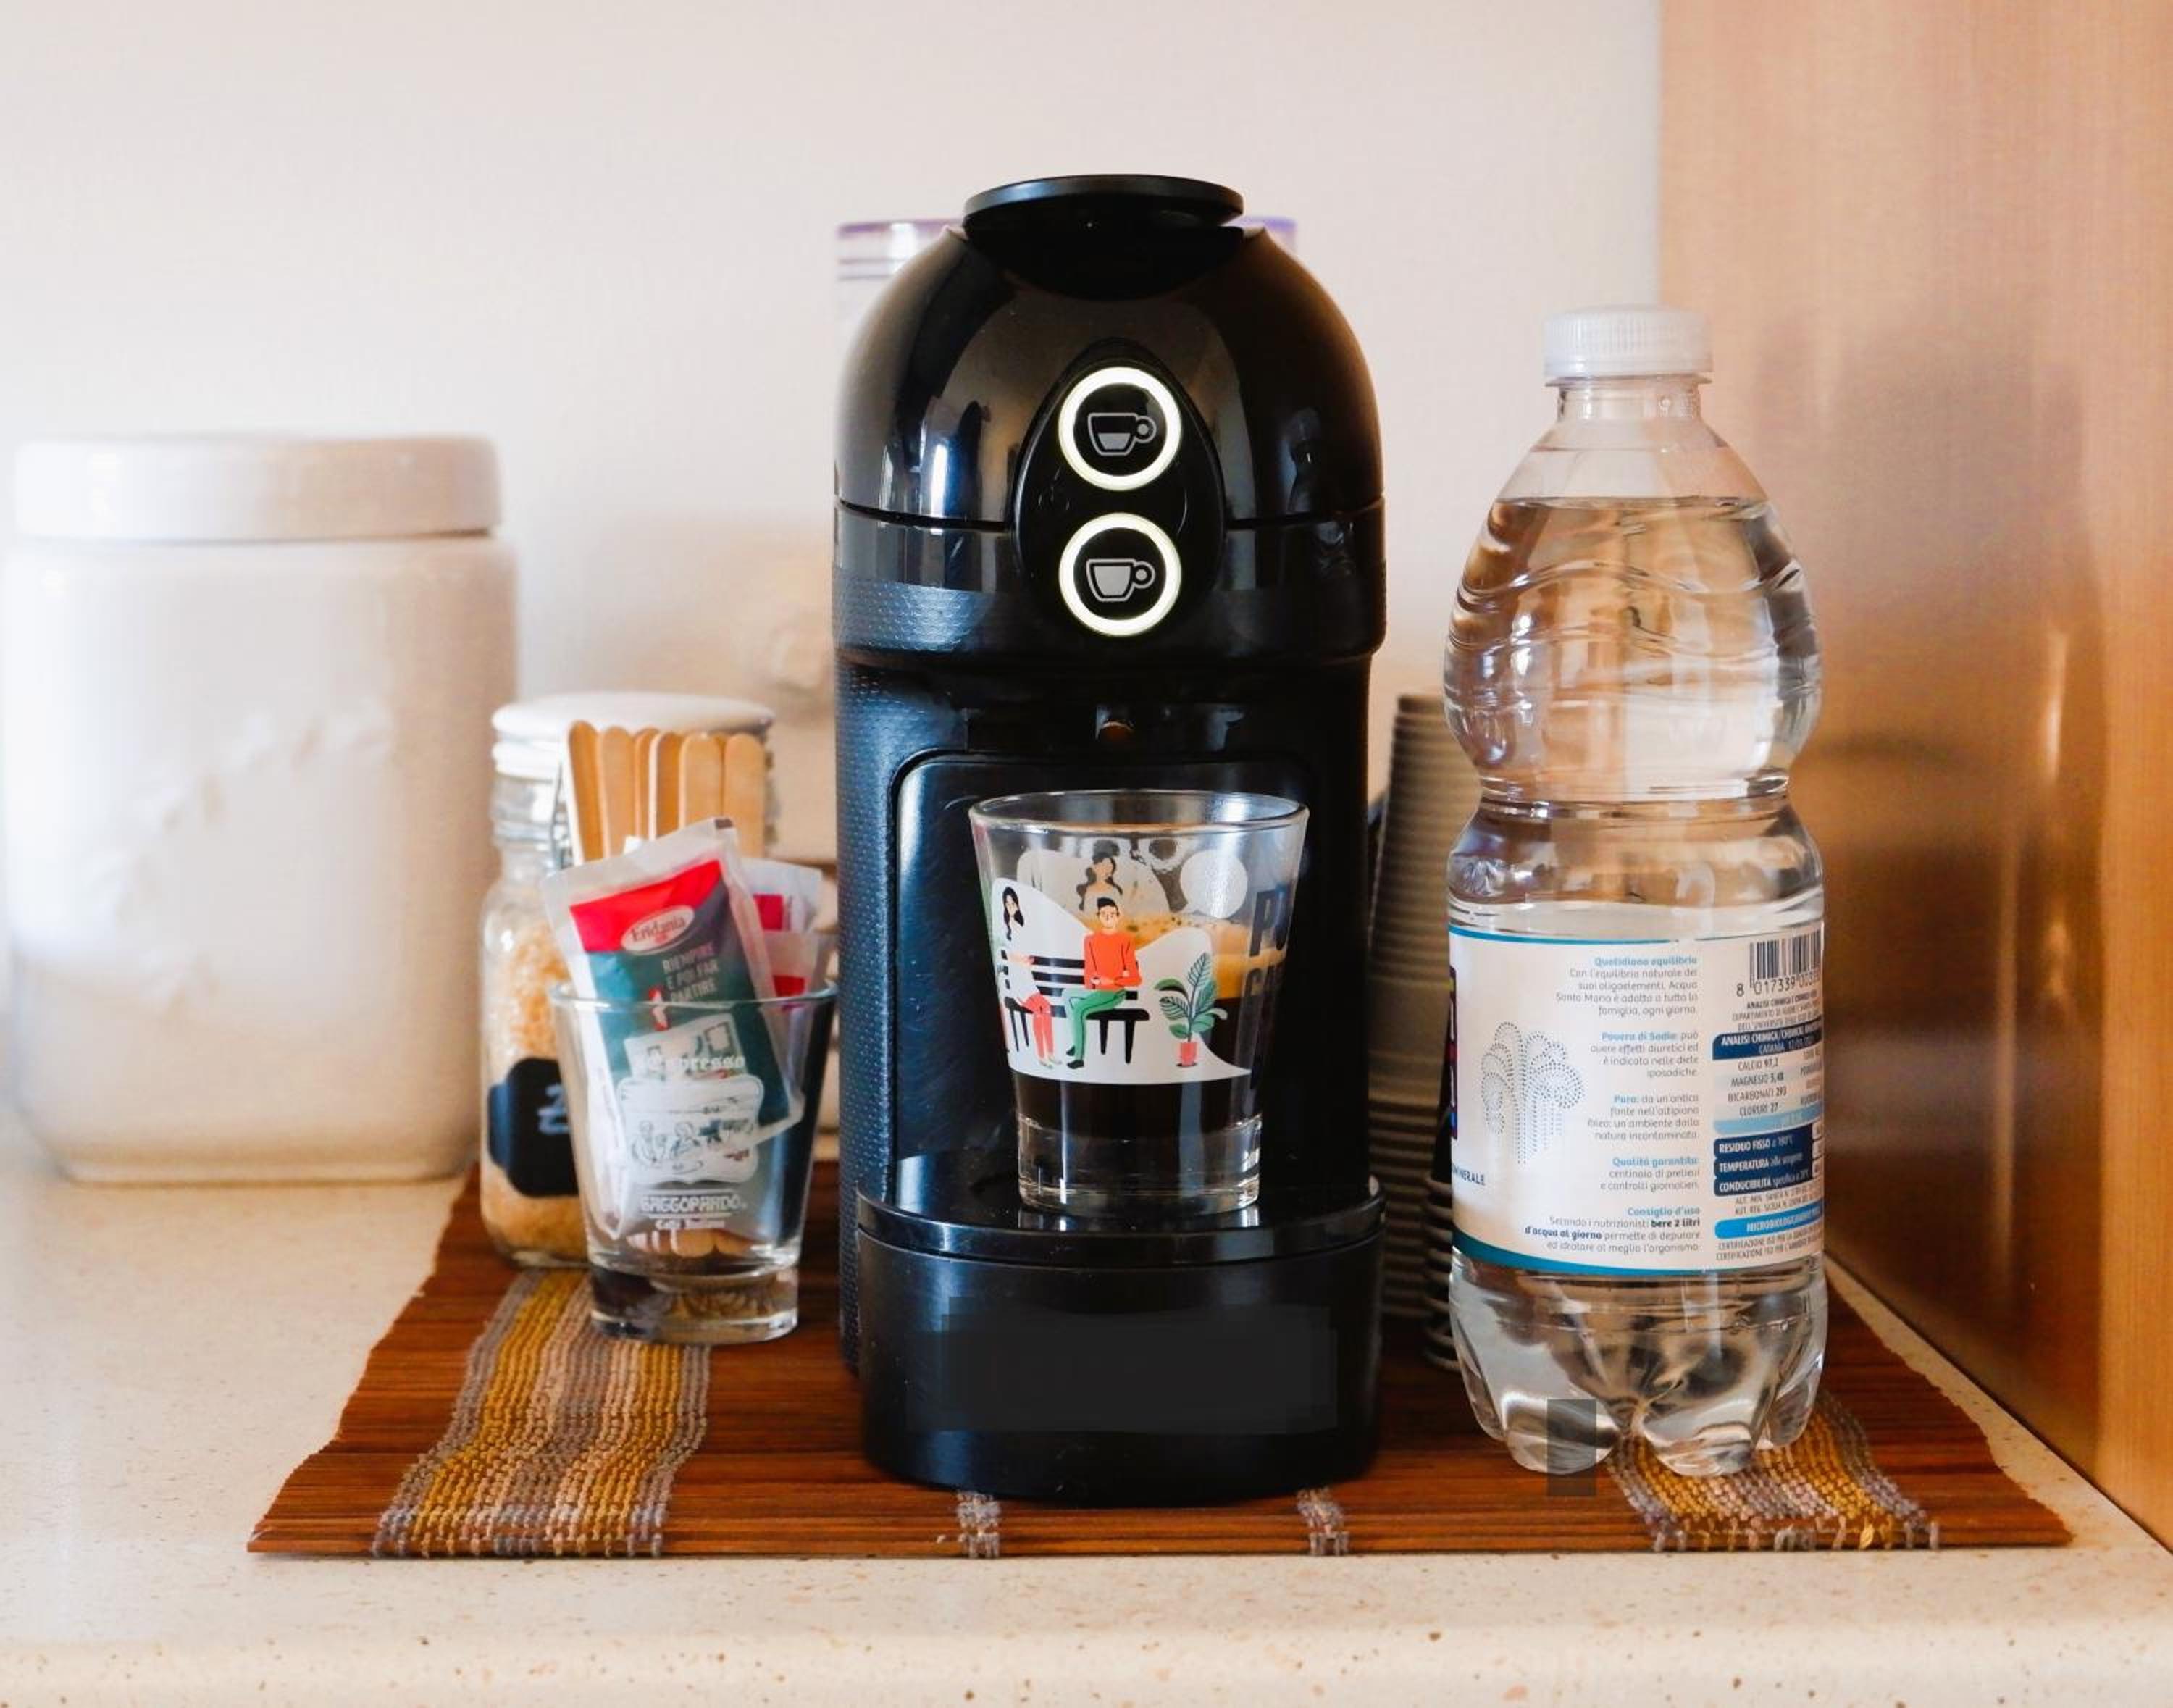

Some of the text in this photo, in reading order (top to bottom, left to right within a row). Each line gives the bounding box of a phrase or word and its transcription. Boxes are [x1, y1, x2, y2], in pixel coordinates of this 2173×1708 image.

[631, 914, 687, 942] Eridania
[662, 941, 716, 974] RIEMPIRE
[1594, 955, 1698, 967] Quotidiano equilibrio
[666, 975, 674, 990] E
[696, 958, 719, 977] FAR
[1570, 967, 1698, 980] Con l'equilibrio naturale dei
[670, 976, 719, 1002] PARTIRE
[1578, 981, 1597, 991] suoi
[1669, 981, 1698, 992] Acqua
[1736, 983, 1745, 997] 8
[1753, 976, 1796, 995] 017339
[1555, 992, 1582, 1002] Santa
[1584, 992, 1612, 1004] Maria
[1621, 993, 1653, 1003] adatta
[1663, 992, 1687, 1002] tutta
[1688, 992, 1698, 1002] la
[1642, 1006, 1664, 1017] ogni
[1638, 1031, 1646, 1041] di
[1680, 1030, 1699, 1042] può
[1720, 1033, 1751, 1046] ANALISI
[1619, 1043, 1646, 1055] effetti
[1648, 1043, 1686, 1053] diuretici
[1687, 1043, 1699, 1052] ed
[1603, 1055, 1699, 1066] è indicata nelle diete
[1738, 1060, 1762, 1072] CALCIO
[1730, 1074, 1768, 1087] MAGNESIO
[1641, 1094, 1654, 1103] da
[1656, 1094, 1699, 1104] un'antica
[1727, 1088, 1774, 1102] BICARBONATI
[1609, 1105, 1700, 1117] fonte nell'altipiano
[1739, 1102, 1779, 1117] CLORURI 27
[1613, 1119, 1626, 1129] un
[1628, 1118, 1673, 1129] ambiente
[1675, 1118, 1700, 1127] dalla
[1594, 1131, 1699, 1141] natura incontaminata.
[1719, 1141, 1751, 1154] RESIDUO
[1752, 1138, 1771, 1150] FISSO
[1612, 1155, 1650, 1167] Qualità
[1719, 1159, 1769, 1173] TEMPERATURA
[1608, 1168, 1700, 1179] centinaia di prelievi
[1607, 1181, 1649, 1191] controlli
[1627, 1206, 1701, 1218] Consiglio d'uso
[1549, 1216, 1587, 1227] Secondo
[1593, 1218, 1649, 1228] nutrizionisti
[1650, 1218, 1673, 1228] bere
[1674, 1218, 1680, 1228] 2
[1682, 1216, 1701, 1227] litri
[1524, 1226, 1701, 1242] d'acqua al giorno permette di depurare
[1546, 1241, 1557, 1250] ed
[1559, 1242, 1594, 1252] idratare
[1596, 1243, 1607, 1252] al
[1608, 1243, 1641, 1255] meglio
[1718, 1239, 1764, 1251] CERTIFICAZIONE
[1715, 1249, 1763, 1262] CERTIFICAZIONE
